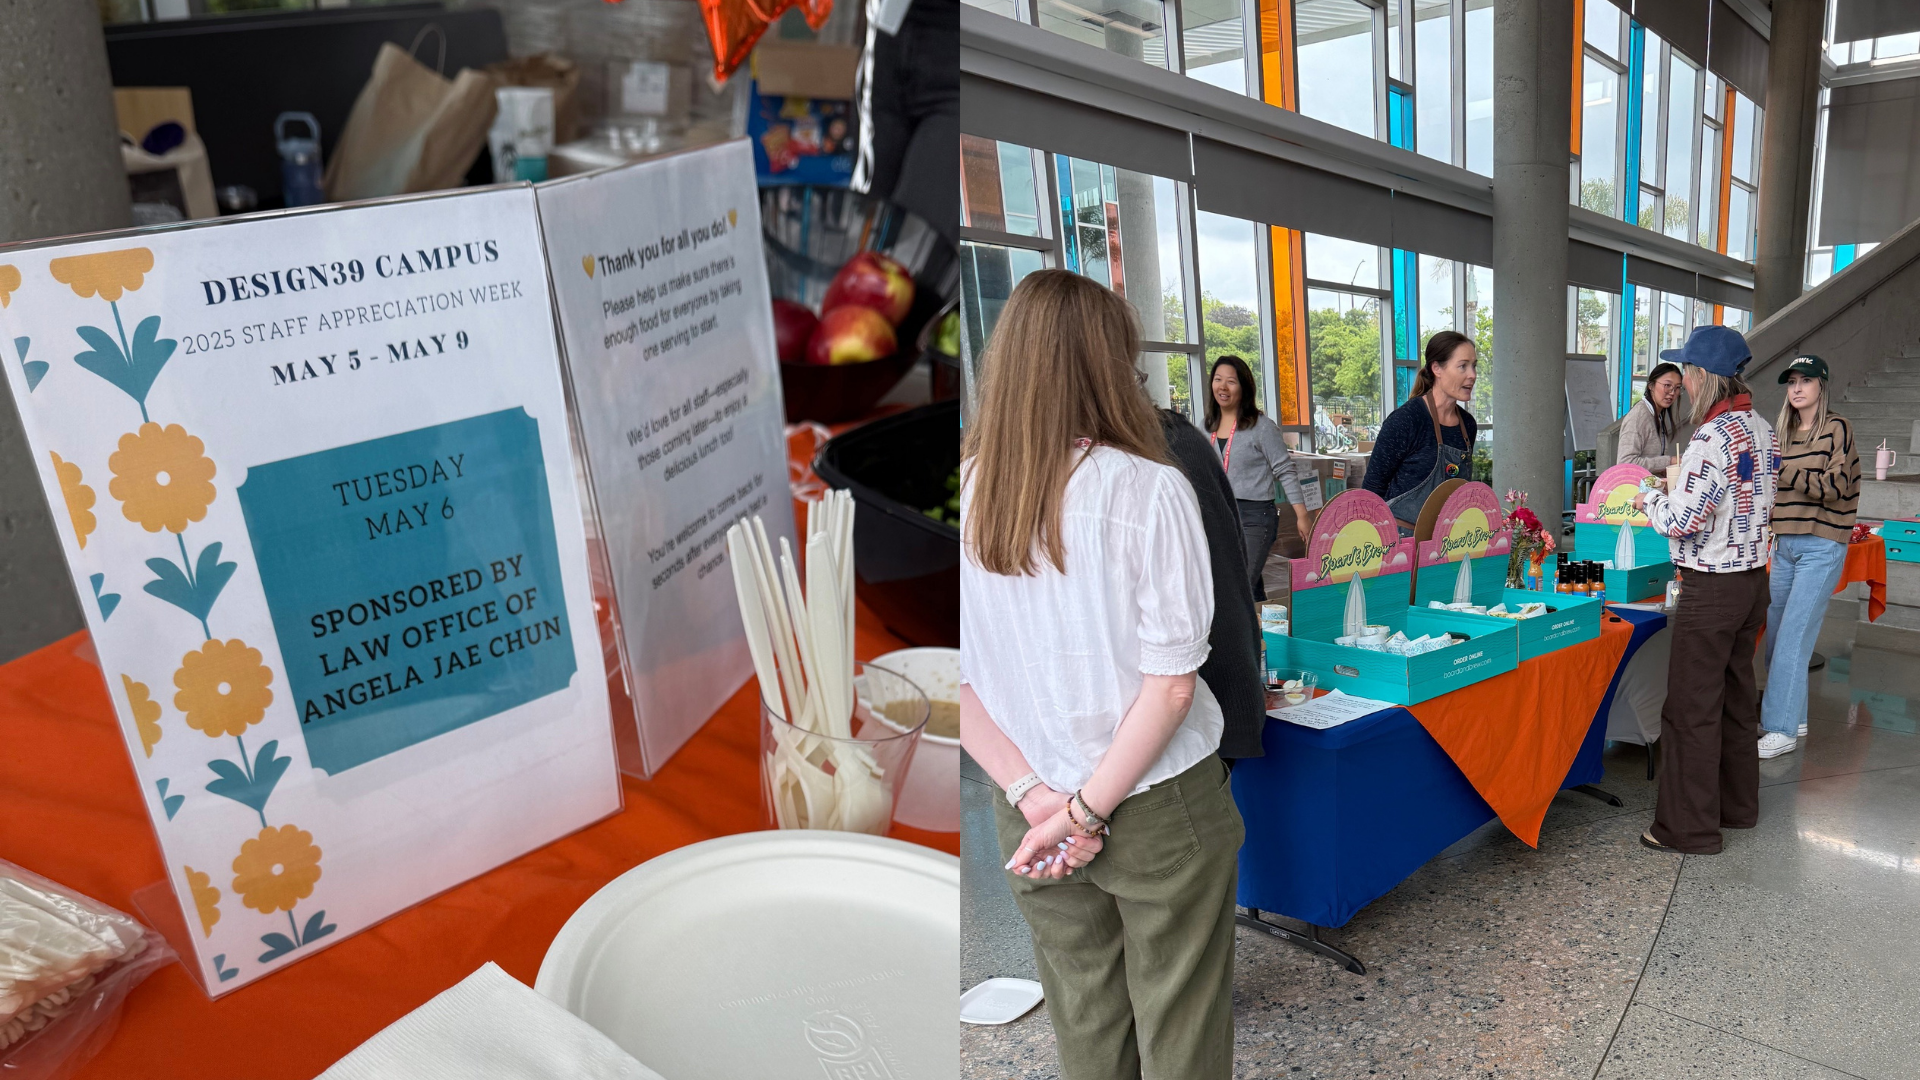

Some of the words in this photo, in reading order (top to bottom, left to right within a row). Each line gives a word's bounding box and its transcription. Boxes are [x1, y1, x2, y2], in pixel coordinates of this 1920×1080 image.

[201, 258, 365, 306] DESIGN39
[375, 239, 500, 279] CAMPUS
[598, 248, 637, 277] Thank
[638, 244, 659, 269] you
[661, 235, 675, 255] for
[677, 229, 690, 249] all
[691, 228, 710, 249] you
[711, 216, 727, 238] do!
[603, 294, 636, 319] Please
[637, 286, 656, 306] help
[657, 281, 668, 296] us
[669, 272, 691, 292] make
[693, 266, 710, 283] sure
[710, 255, 736, 276] there's
[603, 322, 638, 350] enough
[639, 314, 659, 334] food
[660, 308, 671, 325] for
[672, 294, 708, 320] everyone
[709, 287, 720, 305] by
[720, 278, 742, 298] taking
[182, 329, 236, 355] 2025
[243, 316, 309, 345] STAFF
[318, 290, 465, 332] APPRECIATION
[469, 280, 524, 308] WEEK
[643, 344, 659, 361] one
[660, 327, 690, 353] serving
[690, 321, 700, 338] to
[270, 353, 338, 386] MAY
[348, 349, 361, 371] 5
[386, 334, 447, 364] MAY
[456, 330, 470, 350] 9
[626, 420, 650, 447] We'd
[650, 412, 670, 435] love
[669, 405, 681, 424] for
[682, 397, 692, 417] all
[637, 446, 662, 470] those
[662, 428, 692, 455] coming
[723, 396, 743, 418] enjoy
[742, 393, 748, 407] a
[332, 453, 465, 506] TUESDAY
[663, 450, 699, 481] delicious
[698, 436, 719, 459] lunch
[364, 502, 430, 540] MAY
[441, 497, 455, 520] 6
[647, 538, 676, 564] You're
[675, 513, 708, 546] welcome
[707, 506, 717, 522] to
[716, 493, 737, 515] come
[1334, 500, 1384, 529] CLASSIC
[651, 557, 685, 590] seconds
[685, 543, 703, 565] after
[1321, 546, 1356, 580] Board
[1362, 541, 1390, 567] Brew
[310, 568, 483, 639] SPONSORED
[489, 554, 524, 584] BY
[319, 634, 392, 677] LAW
[402, 601, 499, 650] OFFICE
[505, 587, 538, 616] OF
[1453, 655, 1468, 666] ORDER
[1468, 650, 1484, 661] ONLINE
[302, 665, 425, 725] ANGELA
[433, 644, 482, 680] JAE
[488, 616, 562, 659] CHUN
[718, 983, 815, 1011] Commercially
[818, 967, 906, 992] Compostable
[805, 993, 837, 1007] Only
